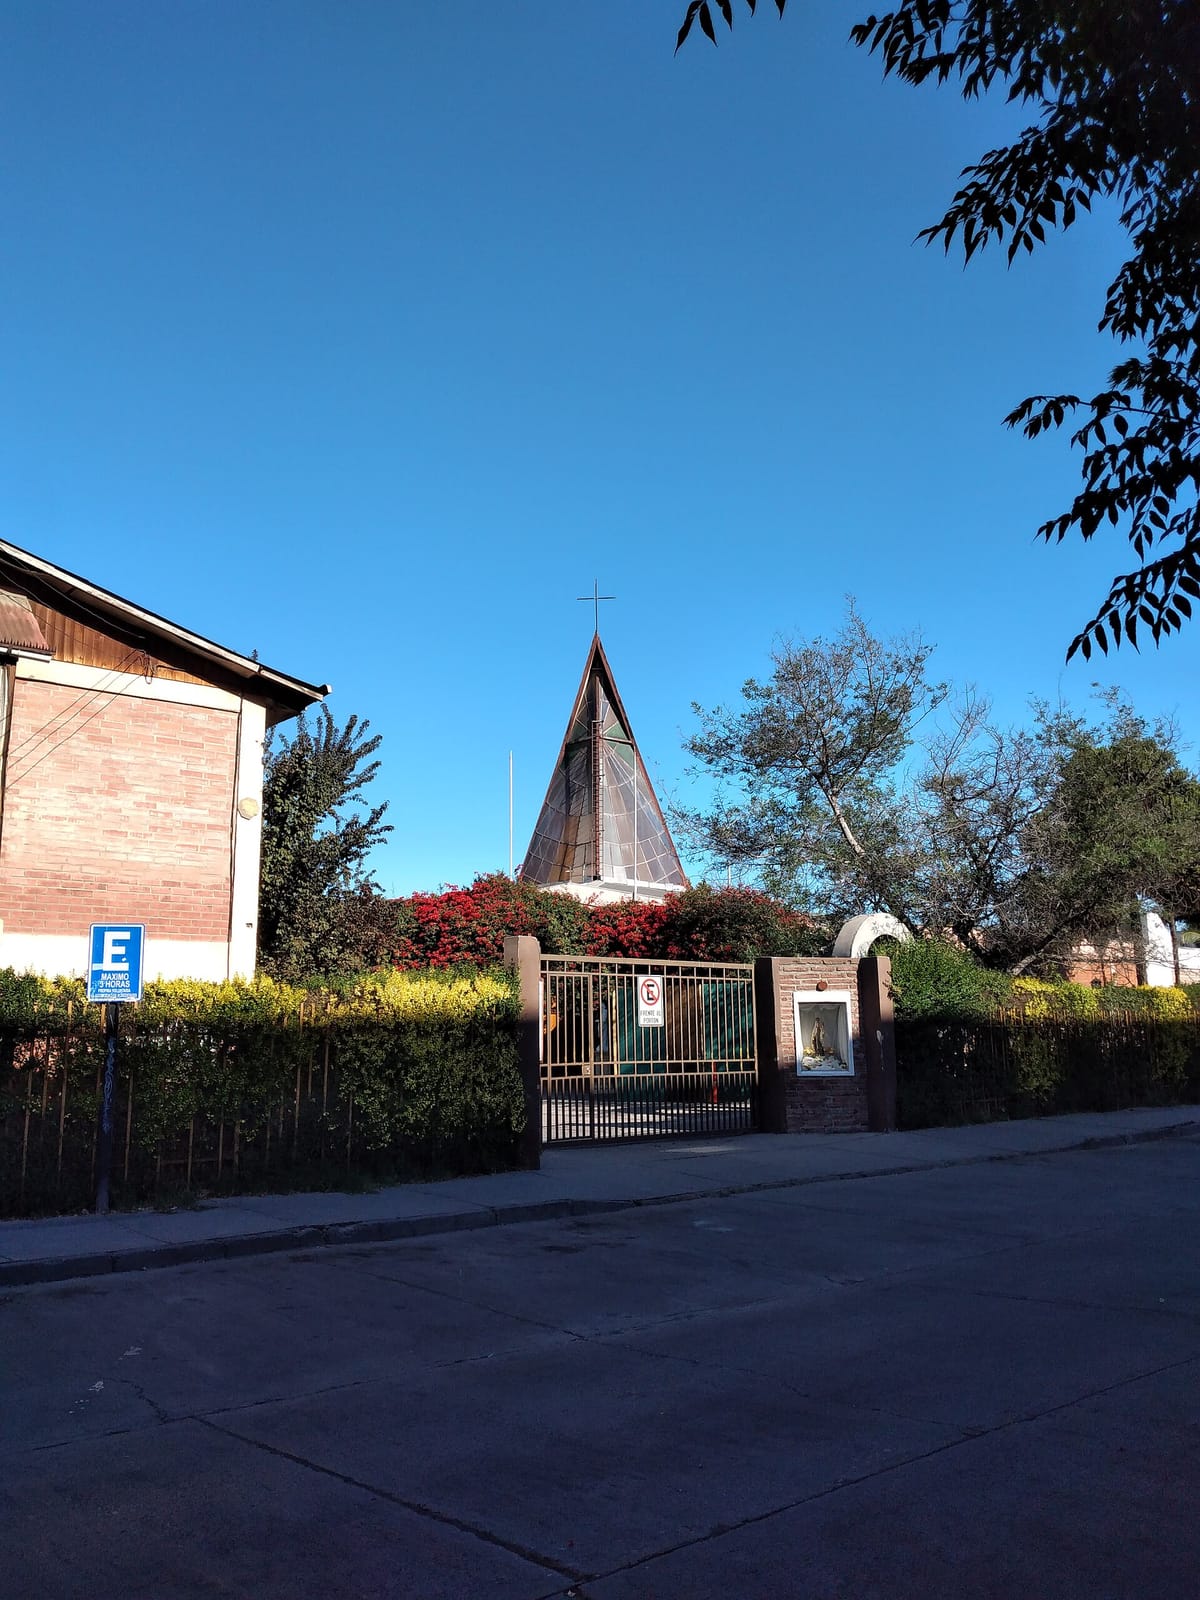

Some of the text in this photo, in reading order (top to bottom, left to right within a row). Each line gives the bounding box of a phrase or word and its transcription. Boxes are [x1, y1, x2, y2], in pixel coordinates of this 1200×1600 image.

[103, 931, 131, 971] E
[101, 973, 130, 981] MAXIMO
[105, 980, 131, 988] HORAS
